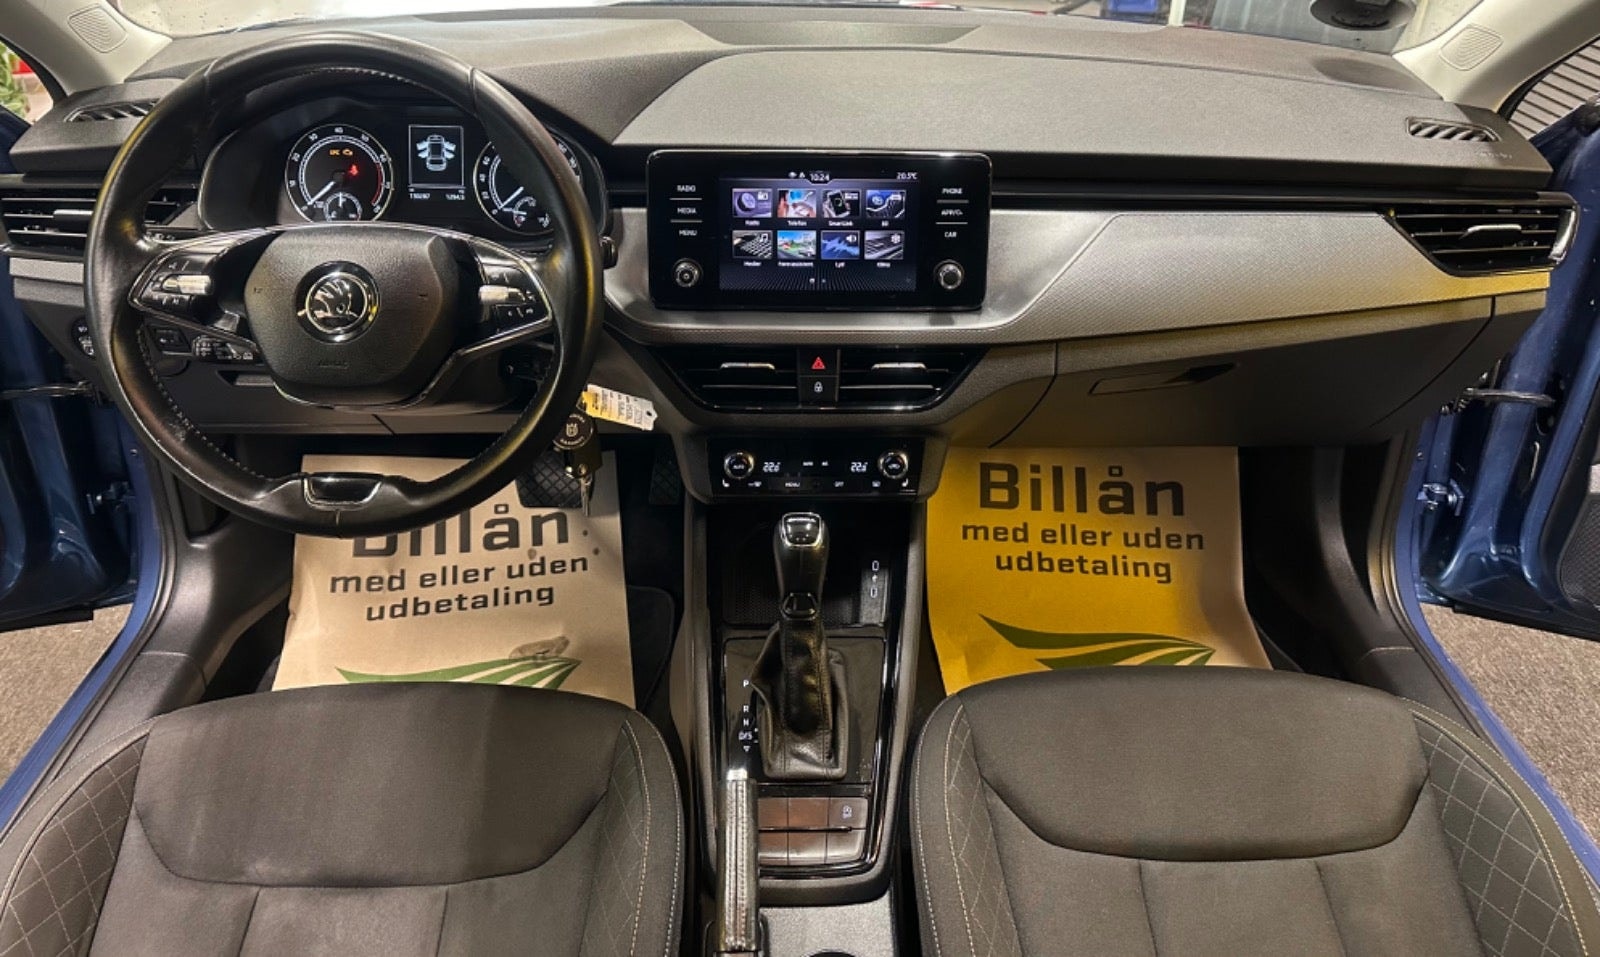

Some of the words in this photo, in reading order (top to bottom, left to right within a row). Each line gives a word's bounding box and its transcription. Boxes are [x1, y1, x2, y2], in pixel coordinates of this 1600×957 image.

[809, 173, 830, 181] 10:24
[676, 184, 697, 193] RADIO
[941, 187, 963, 195] PHONE
[677, 207, 697, 215] MEDIA
[787, 219, 807, 227] Telefon
[979, 461, 1185, 517] Billån
[961, 521, 1029, 544] med
[1040, 522, 1113, 547] eller
[1122, 526, 1205, 551] uden
[994, 550, 1172, 584] udbetaling
[329, 568, 406, 594] med
[419, 564, 495, 589] eller
[506, 555, 588, 580] uden
[366, 585, 555, 621] udbetaling
[743, 679, 750, 688] P
[743, 704, 750, 713] R
[743, 718, 750, 727] N
